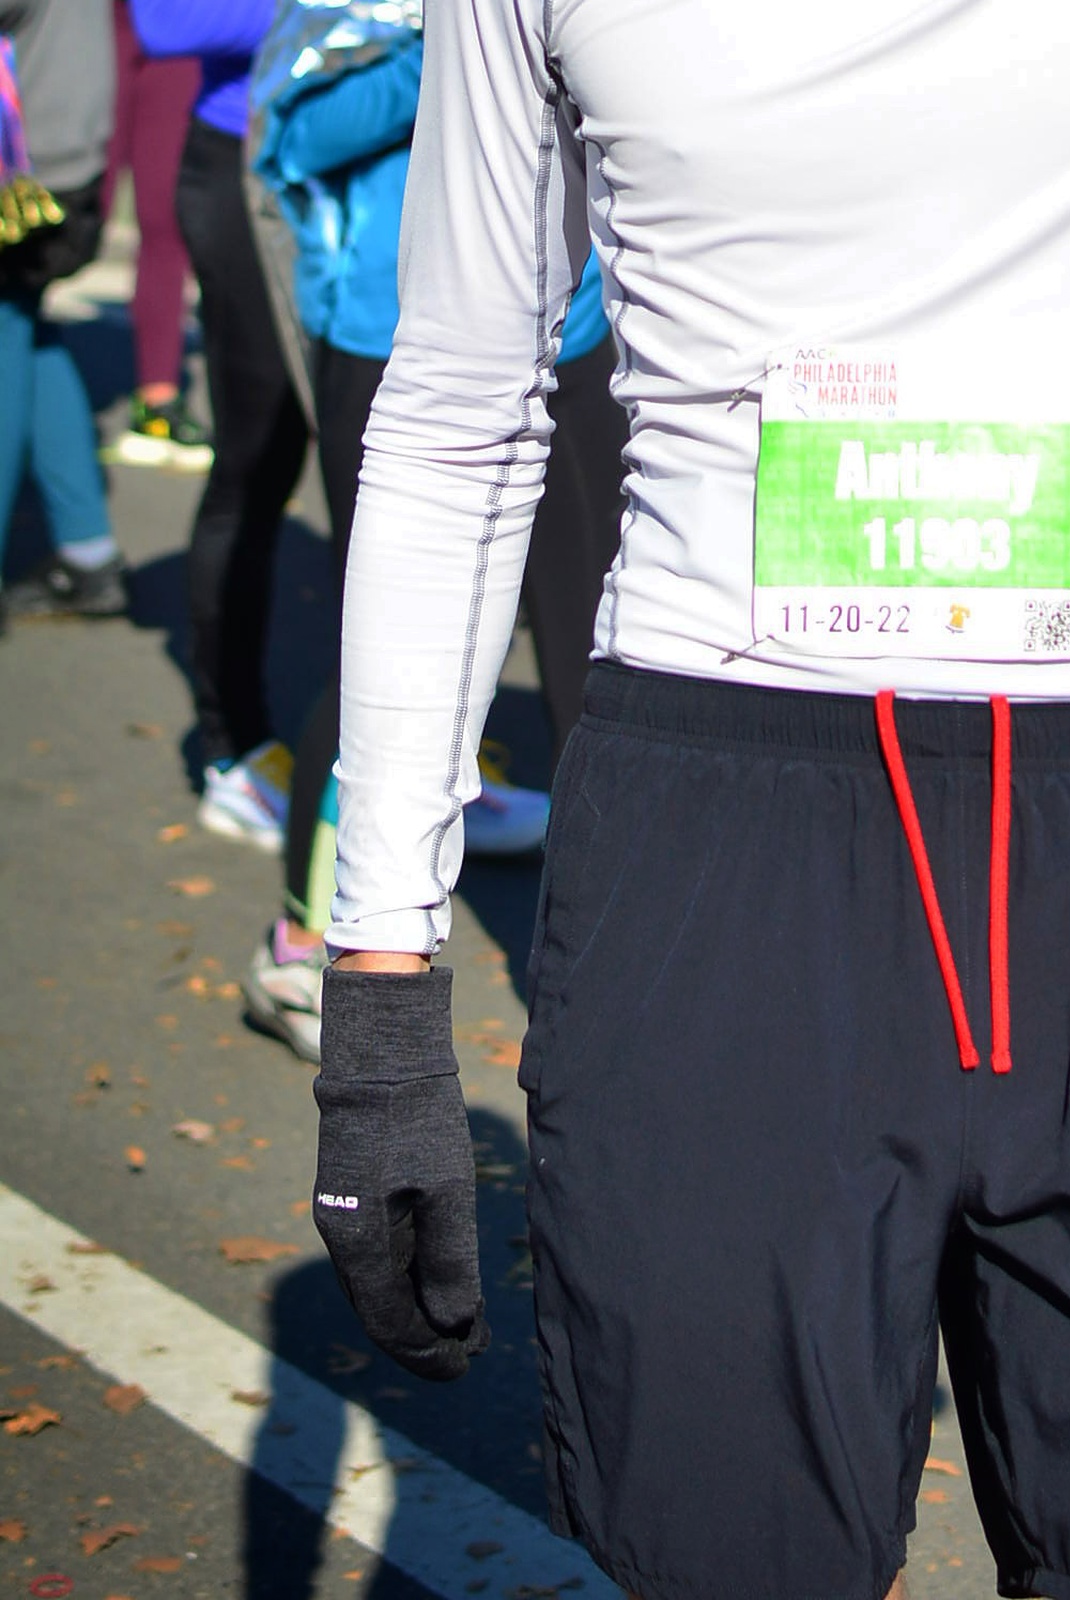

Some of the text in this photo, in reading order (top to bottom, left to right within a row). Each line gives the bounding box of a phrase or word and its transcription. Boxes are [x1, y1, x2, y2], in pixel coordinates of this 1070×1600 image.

[793, 362, 897, 383] PHILADELPHIA
[817, 385, 897, 406] MARATHON
[781, 605, 911, 633] 11-20-22
[318, 1192, 358, 1209] HEAD
